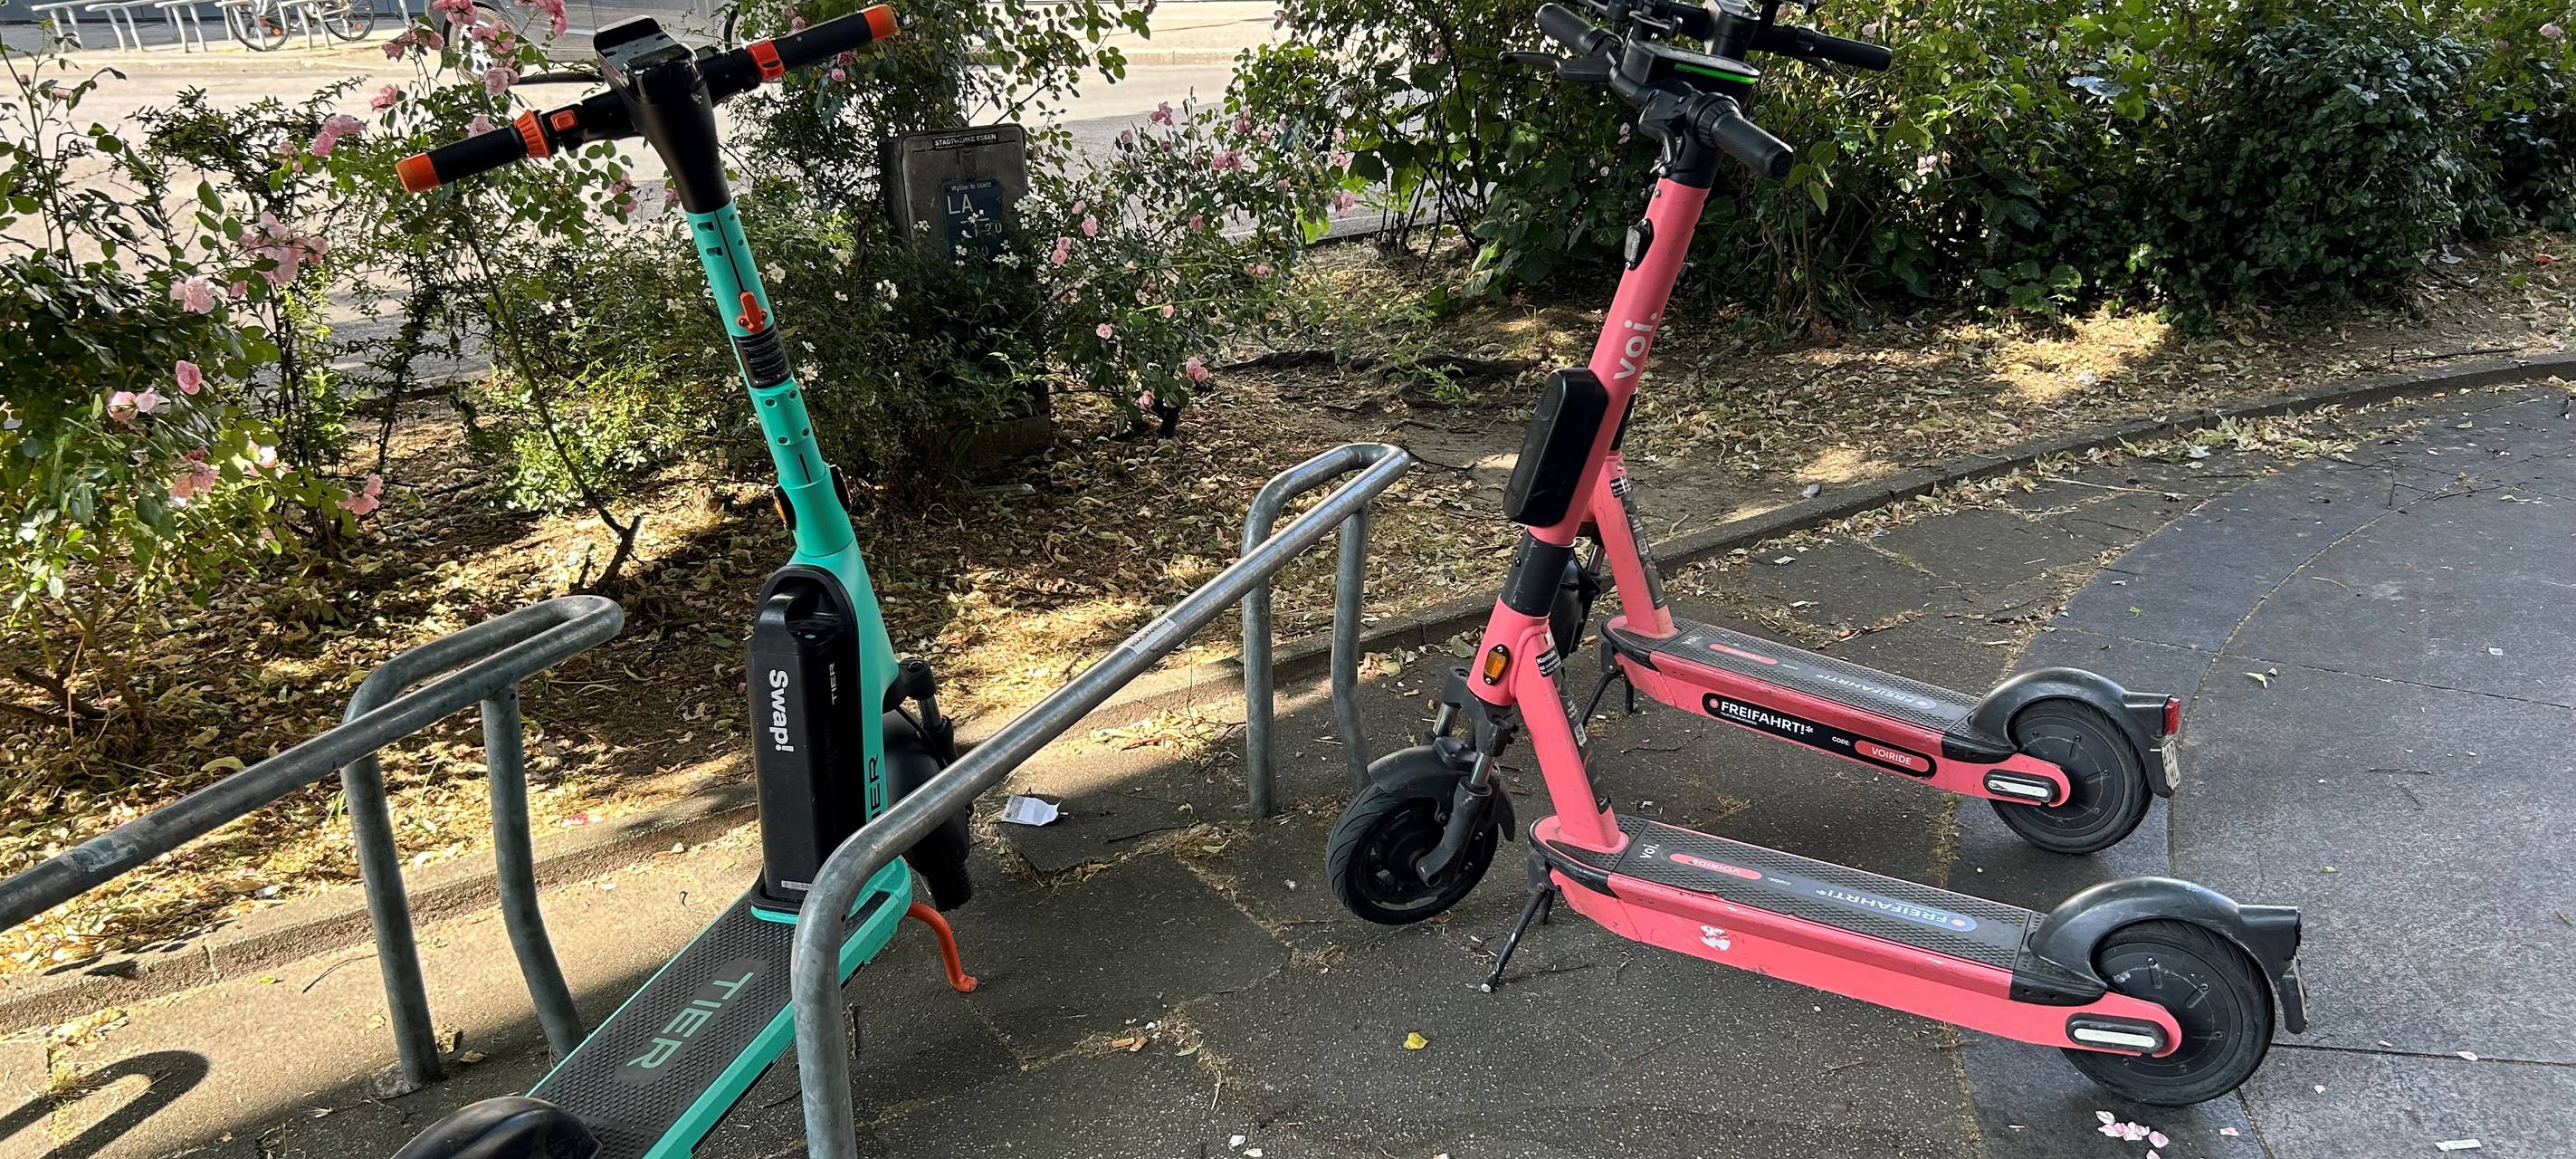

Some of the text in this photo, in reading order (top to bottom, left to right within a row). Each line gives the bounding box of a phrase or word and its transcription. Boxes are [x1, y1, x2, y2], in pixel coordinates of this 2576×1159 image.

[947, 194, 973, 215] LA
[769, 669, 795, 752] Swap!
[829, 662, 837, 705] TIER
[1871, 746, 1912, 766] VOIRIDE
[869, 753, 882, 819] IER
[626, 972, 754, 1068] TIER
